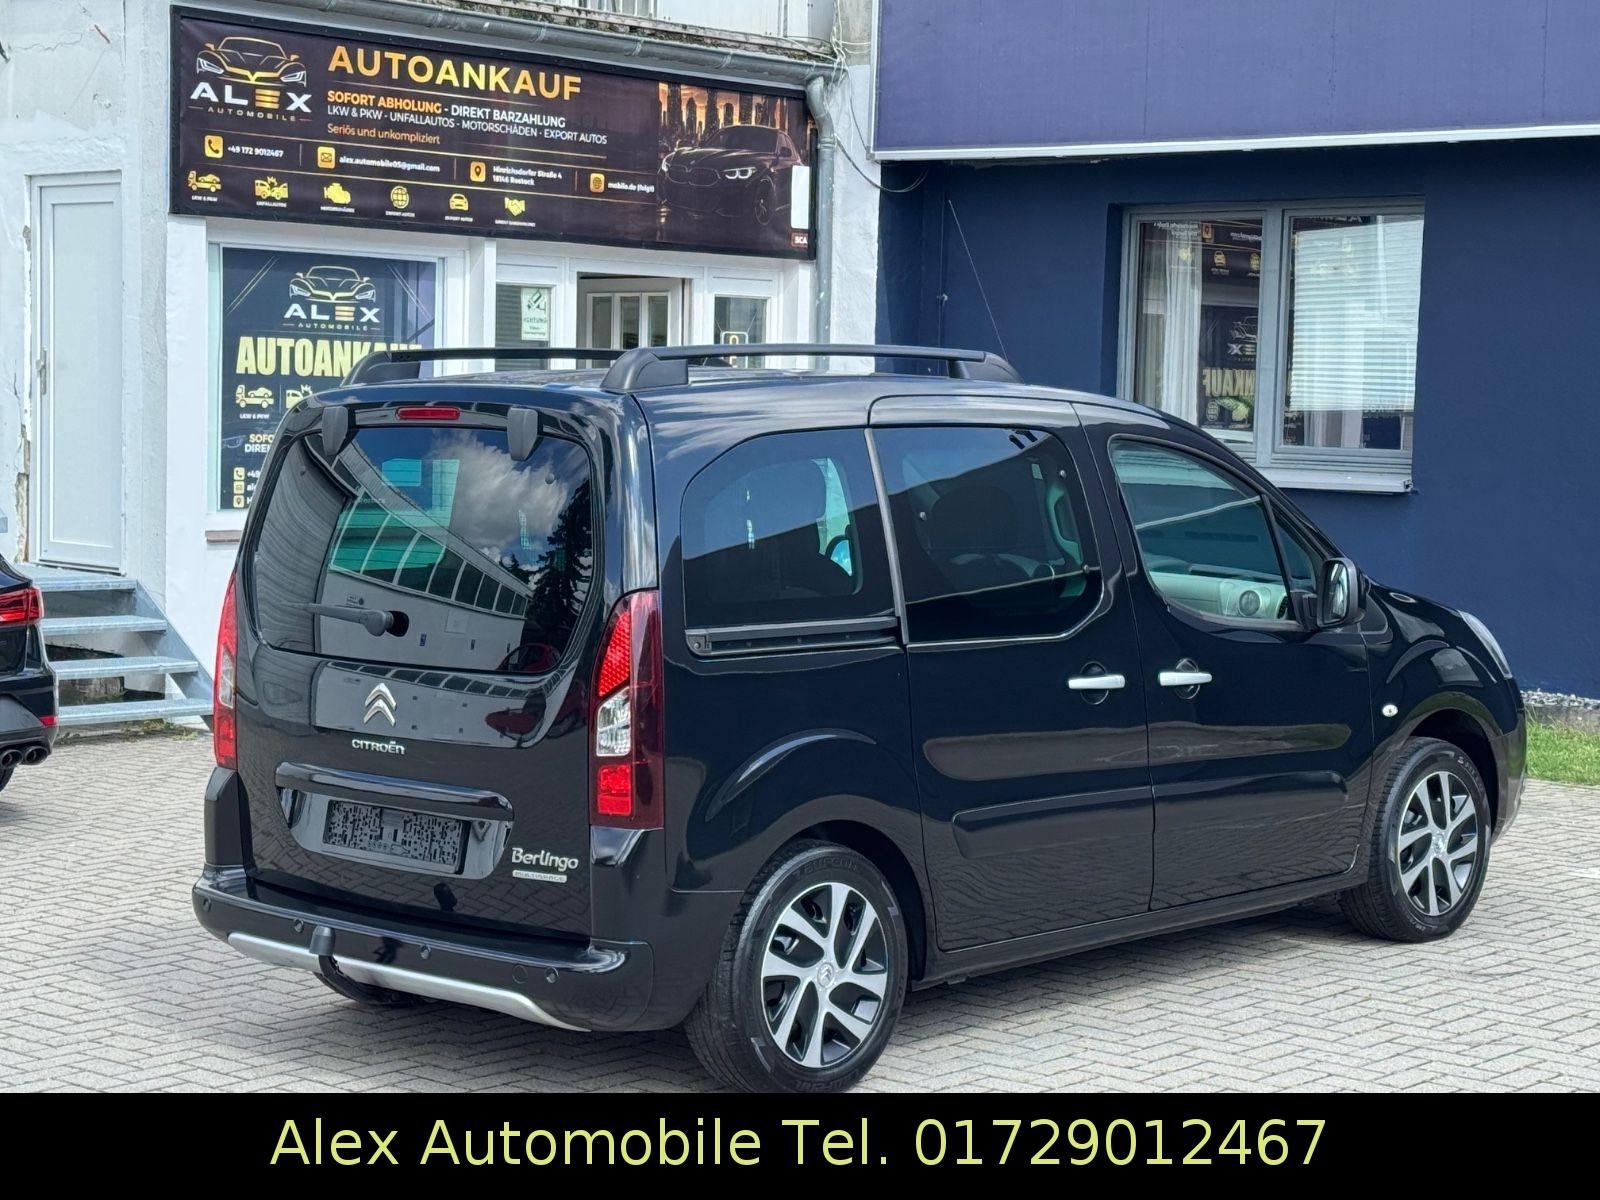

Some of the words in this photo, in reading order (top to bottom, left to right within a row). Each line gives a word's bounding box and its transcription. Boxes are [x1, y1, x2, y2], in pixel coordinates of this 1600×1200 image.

[328, 45, 582, 101] AUTOANKAUF
[190, 81, 312, 113] ALEX
[208, 106, 296, 121] AUTOMOBILE
[327, 90, 375, 106] SOFORT
[378, 96, 442, 114] ABHOLUNG
[451, 104, 491, 120] DIREKT
[493, 109, 566, 128] BARZAHLUNG
[327, 105, 350, 117] LKW
[351, 107, 358, 118] &
[360, 108, 383, 120] PKW
[389, 111, 455, 129] UNFALLAUTOS
[461, 120, 537, 138] MOTORSCHÄDEN
[544, 129, 578, 142] EXPORT
[579, 132, 608, 145] AUTOS
[327, 122, 355, 136] Seriös
[357, 127, 376, 138] und
[378, 129, 440, 144] unkompliziert
[241, 146, 253, 155] 172
[284, 303, 380, 323] ALEX
[298, 322, 368, 331] AUTOMOBILE
[511, 847, 579, 872] Berlingo
